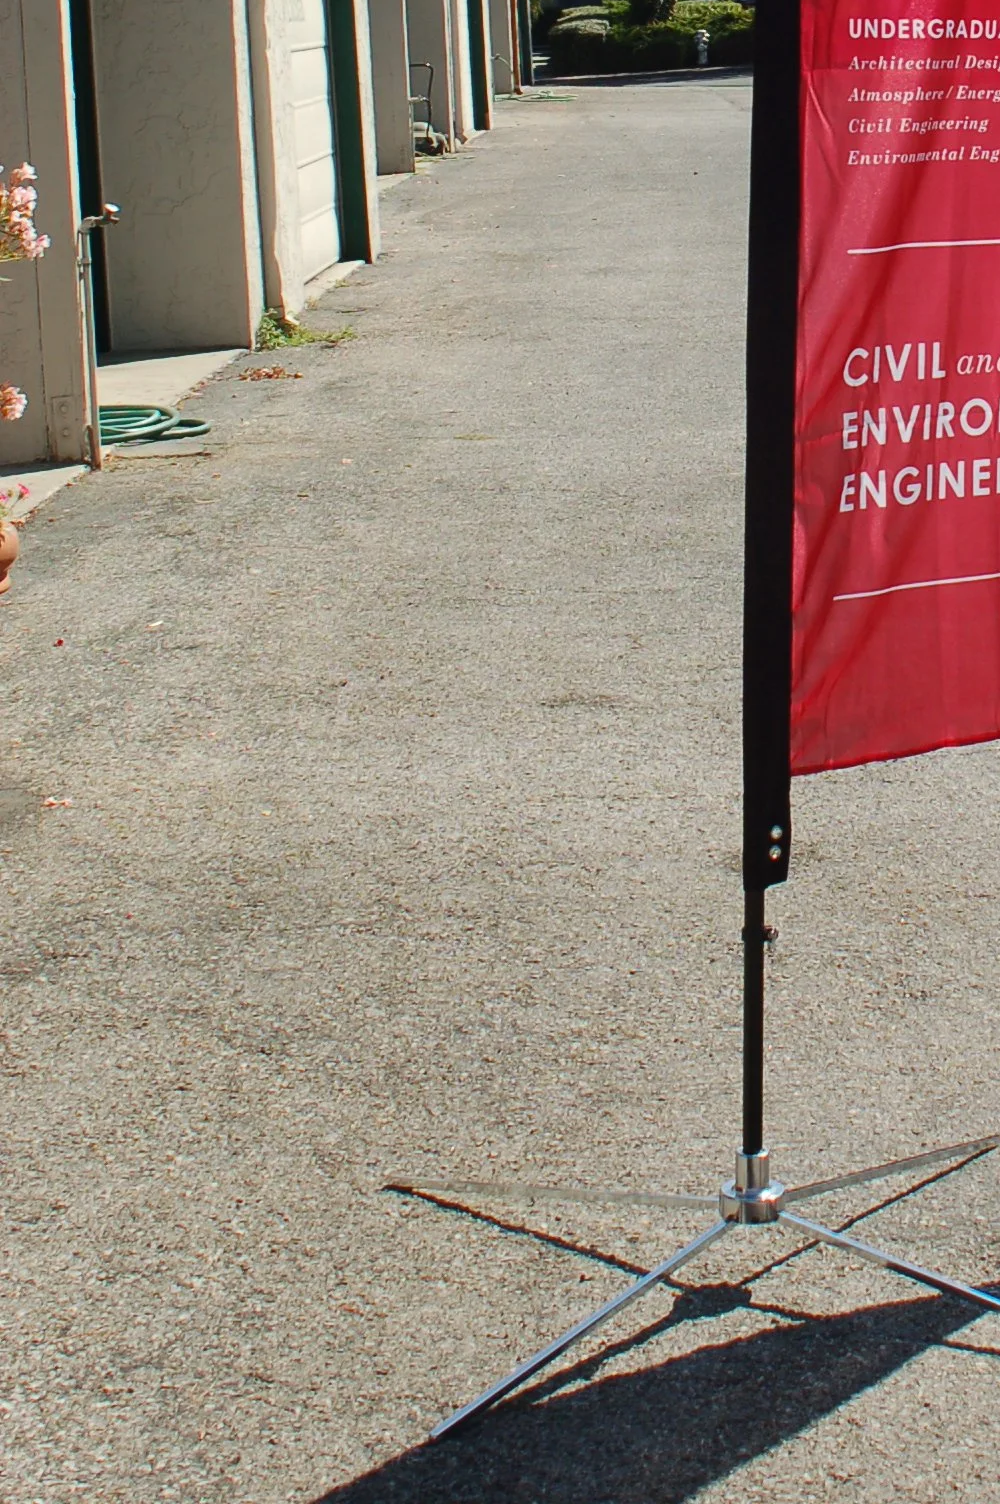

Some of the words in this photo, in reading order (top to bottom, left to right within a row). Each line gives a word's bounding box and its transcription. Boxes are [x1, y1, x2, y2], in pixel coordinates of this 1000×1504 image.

[848, 55, 960, 72] Architectural
[848, 117, 892, 133] Civil
[899, 116, 989, 135] Engineering
[847, 146, 965, 165] Environmental
[843, 341, 946, 387] CIVIL
